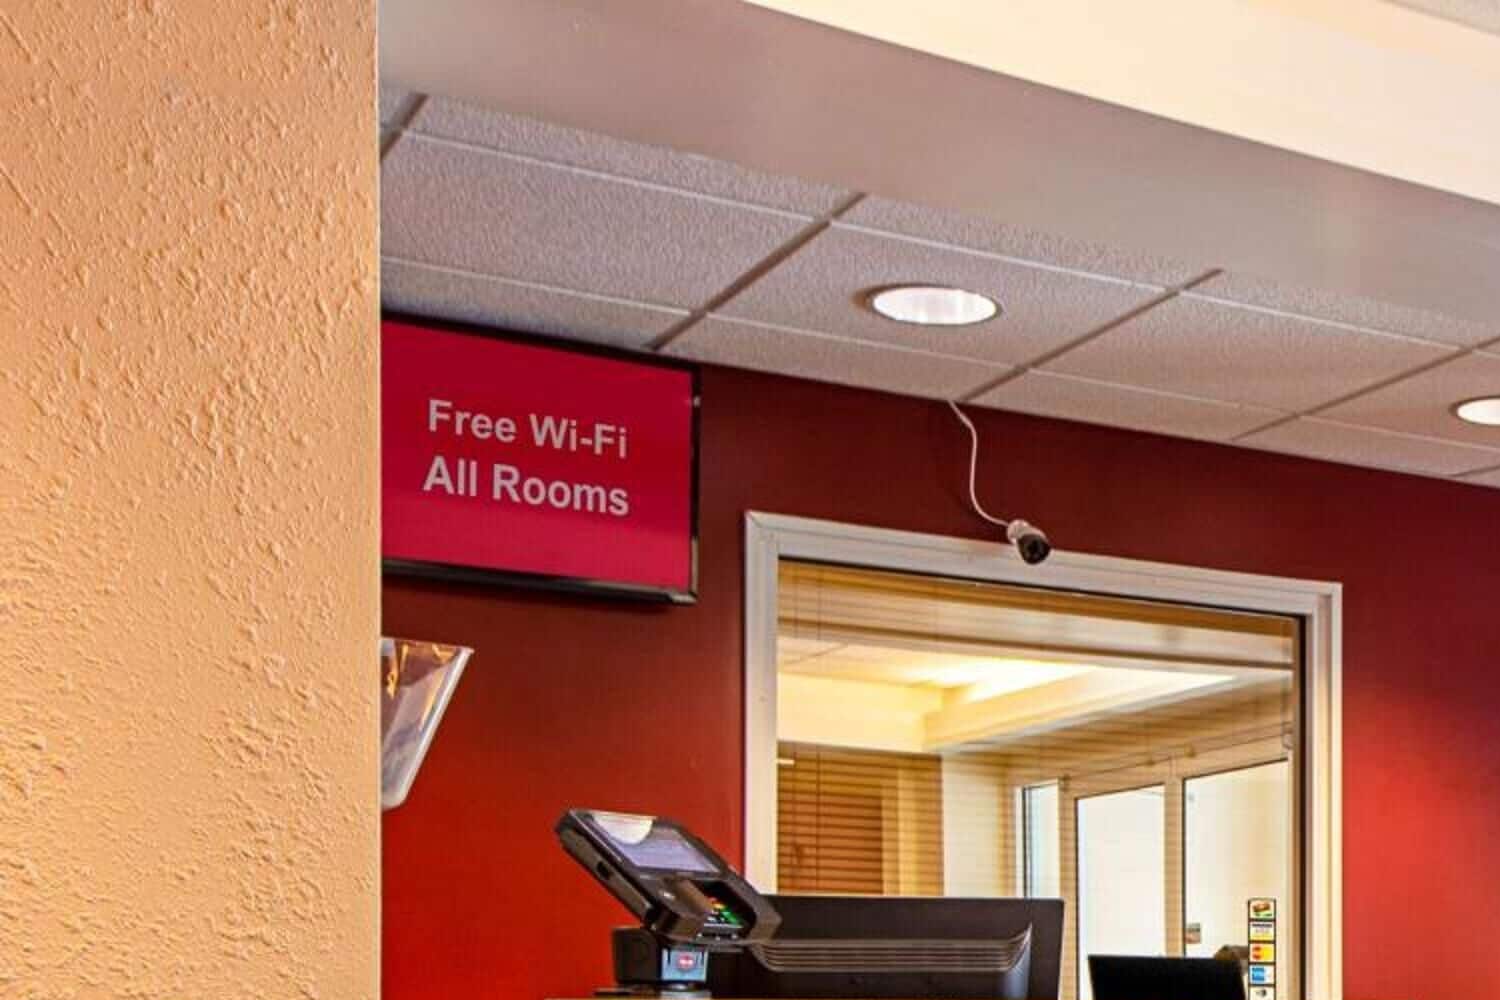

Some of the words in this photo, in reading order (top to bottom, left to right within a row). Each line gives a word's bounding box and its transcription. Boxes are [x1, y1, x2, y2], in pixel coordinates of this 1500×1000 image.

[428, 398, 517, 443] Free
[529, 413, 628, 459] Wi-Fi
[423, 455, 478, 497] All
[492, 463, 630, 516] Rooms
